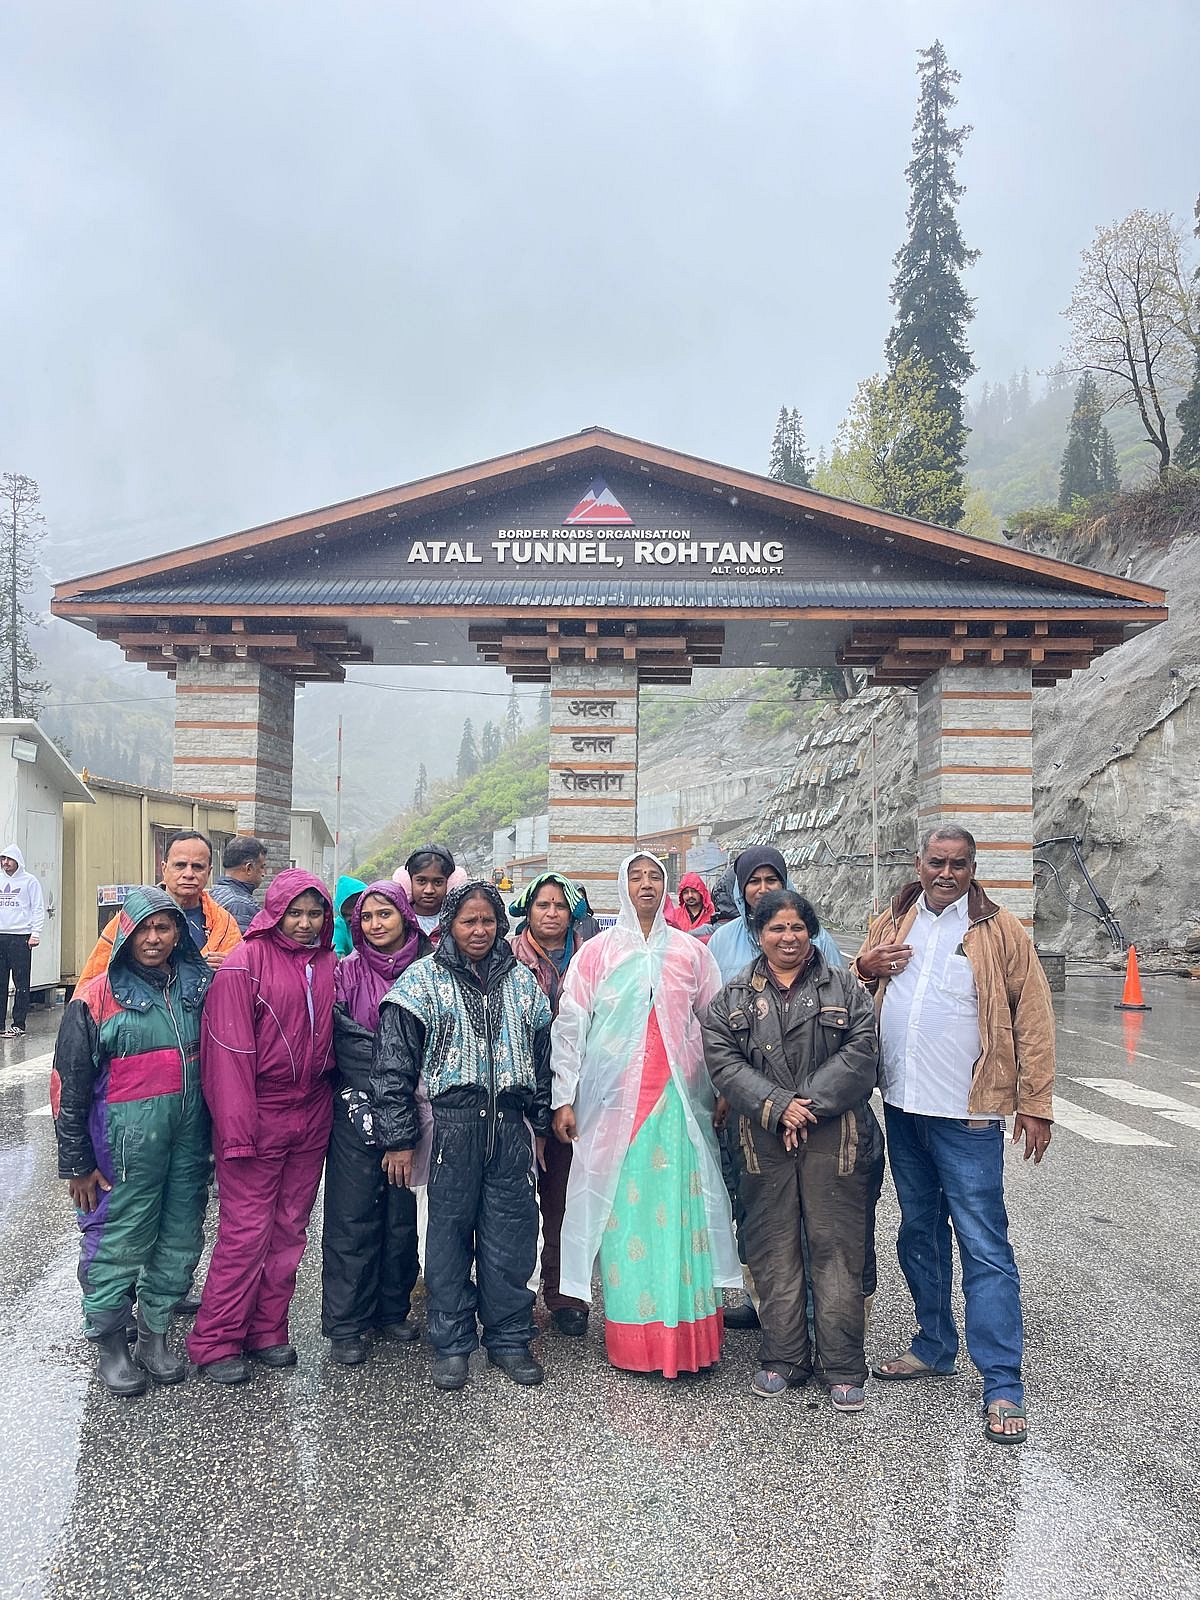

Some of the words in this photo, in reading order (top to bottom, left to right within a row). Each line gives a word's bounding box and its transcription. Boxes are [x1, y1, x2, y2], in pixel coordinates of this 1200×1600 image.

[498, 529, 549, 539] BORDER
[552, 529, 593, 539] ROADS
[596, 529, 691, 539] ORGANISATION
[407, 541, 483, 563] ATAL
[491, 541, 624, 568] TUNNEL,
[634, 541, 784, 564] ROHTANG
[711, 566, 731, 575] ALT.
[734, 566, 768, 576] 10,040
[769, 566, 784, 575] FT.
[568, 700, 617, 717] अटल
[570, 736, 615, 753] टनल
[559, 767, 625, 791] रोहतांग
